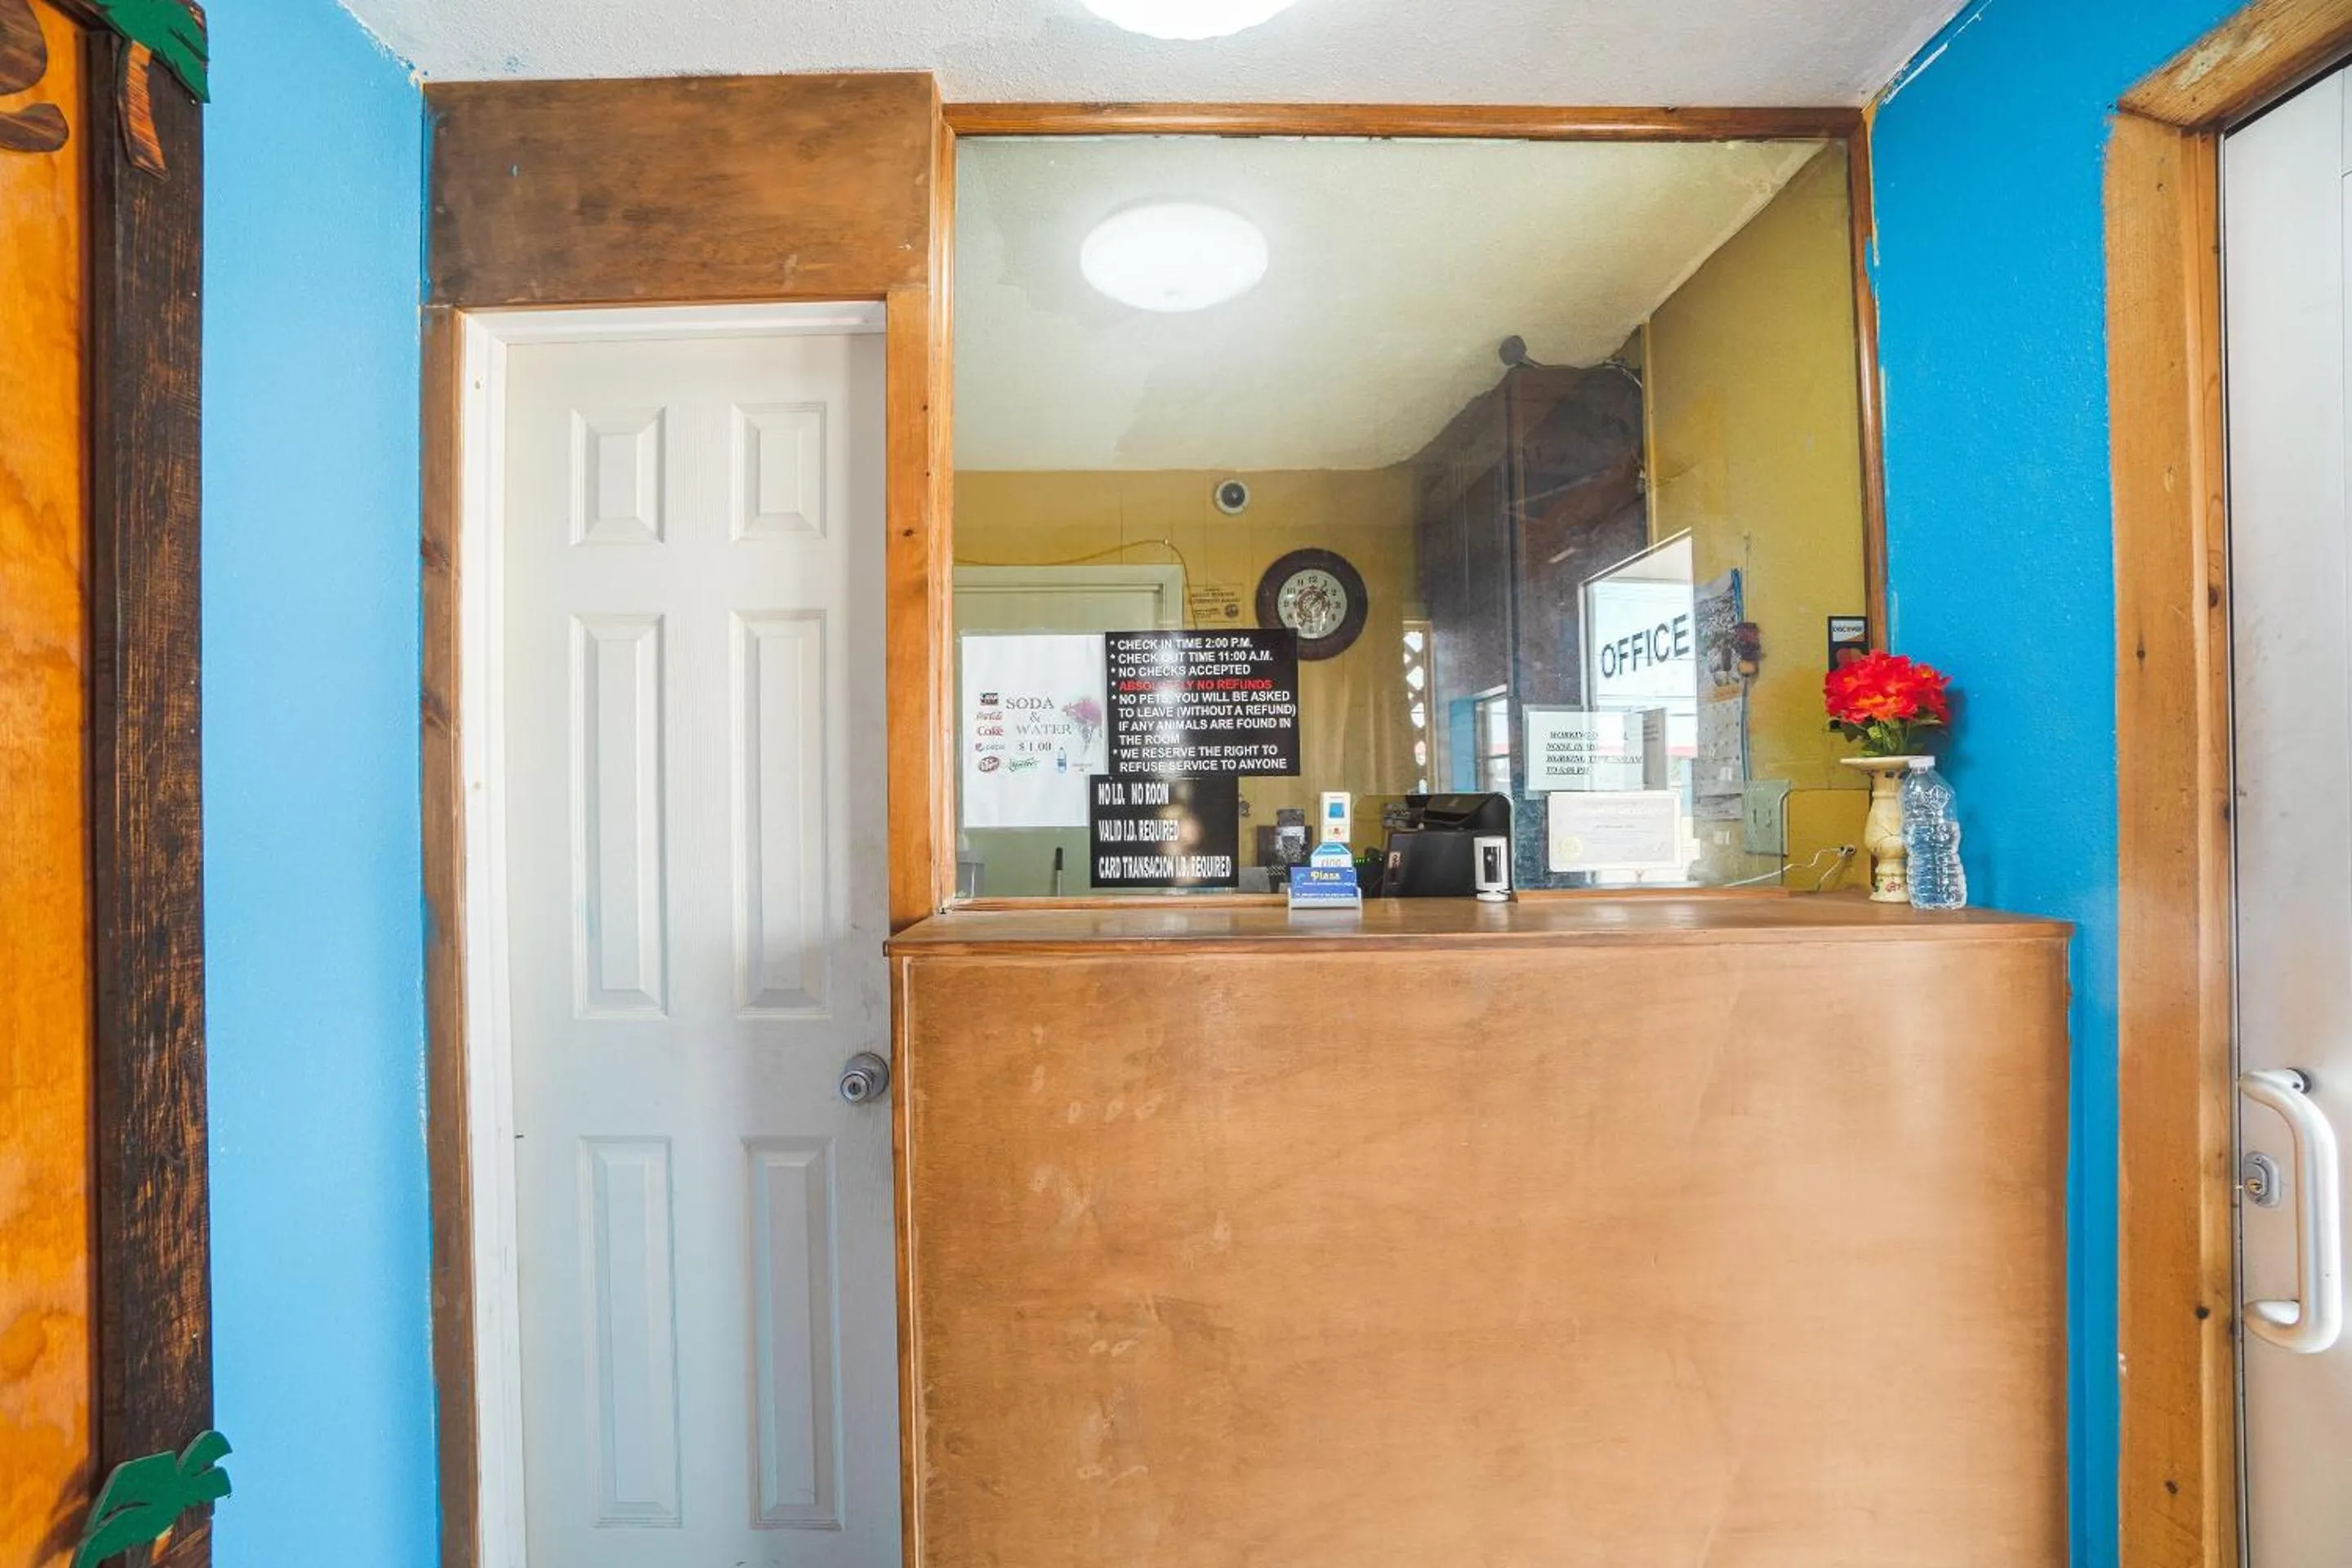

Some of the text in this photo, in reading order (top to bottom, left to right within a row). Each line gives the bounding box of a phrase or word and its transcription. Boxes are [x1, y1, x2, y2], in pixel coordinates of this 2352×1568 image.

[1117, 638, 1254, 650] CHECK IN TIME 2:00 P.M.
[1601, 612, 1690, 679] OFFICE
[1118, 651, 1273, 664] CHECK OUT TIME 11:00 A.M.
[1119, 664, 1251, 678] NO CHECKS ACCEPTED
[1119, 679, 1272, 692] ABSOLY NO REFUNDS
[1005, 696, 1054, 710] SODA
[1119, 694, 1136, 705] NO
[1176, 693, 1199, 703] YOU
[1202, 693, 1230, 702] WILL
[1232, 692, 1249, 702] BE
[1250, 691, 1290, 702] ASKED
[1029, 711, 1040, 723] &
[1118, 704, 1296, 718] TO LEAVE (WITHOUT A REFUND)
[977, 725, 1004, 736] Coke
[1016, 724, 1072, 735] WATER
[1119, 717, 1291, 732] IF ANY ANIMALS ARE FOUND IN
[1119, 733, 1180, 746] THE ROOM
[1120, 745, 1277, 759] WE RESERVE THE RIGHT TO
[1120, 758, 1287, 773] REFUSE SERVICE TO ANYONE
[1098, 782, 1111, 805] NO
[1131, 782, 1143, 805] NO
[1145, 782, 1169, 805] ROOM
[1098, 819, 1122, 841] VALID
[1138, 819, 1179, 841] REQUIRED
[1098, 856, 1121, 879] CARD
[1191, 856, 1232, 878] REQUIRED
